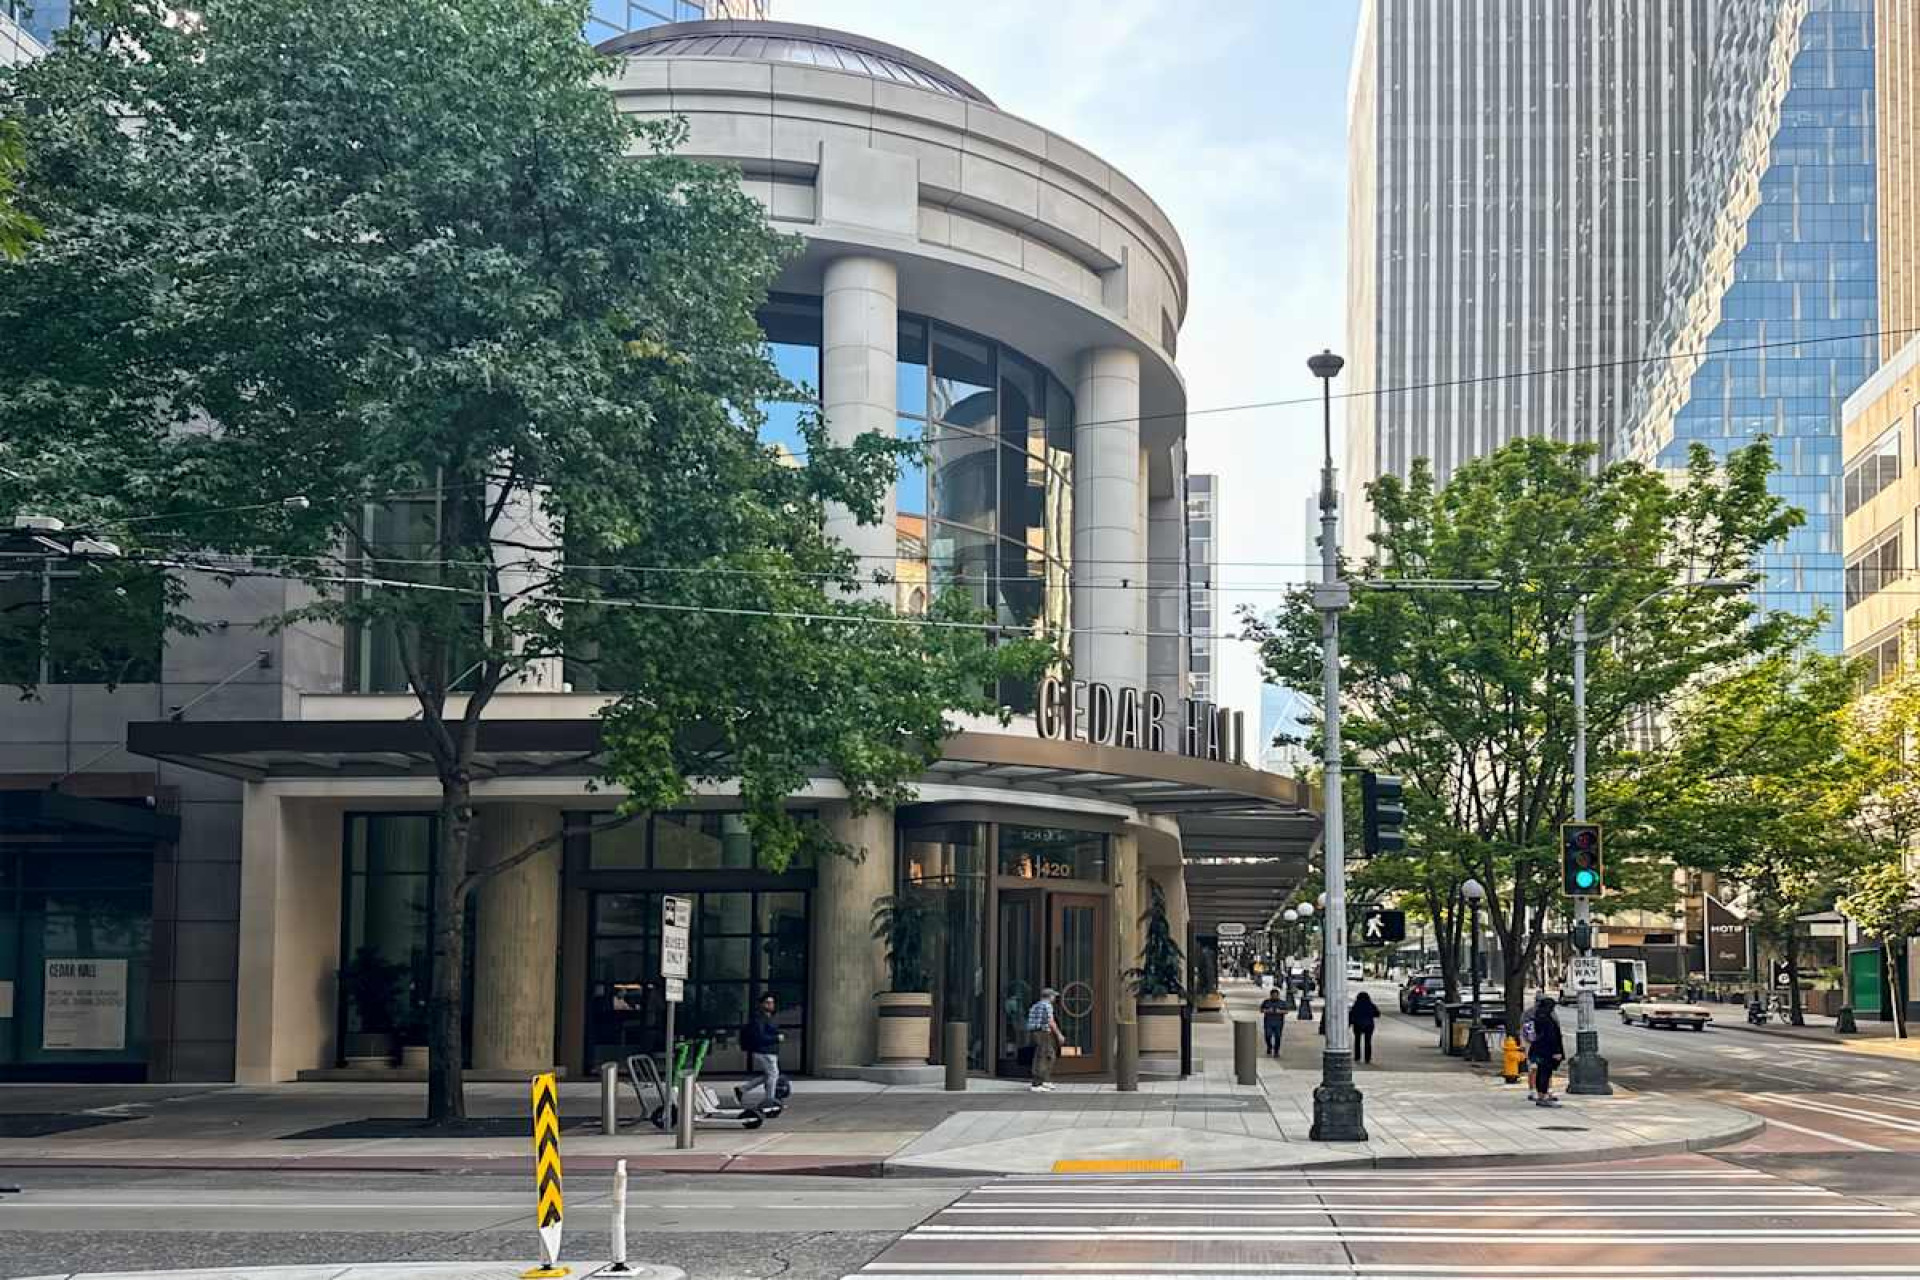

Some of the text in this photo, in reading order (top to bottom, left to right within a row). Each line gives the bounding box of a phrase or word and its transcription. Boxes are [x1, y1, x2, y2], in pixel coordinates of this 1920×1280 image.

[1037, 676, 1165, 752] CEDAR
[1575, 959, 1598, 968] ONE
[49, 964, 76, 978] CEDAR
[1575, 969, 1597, 978] WAY
